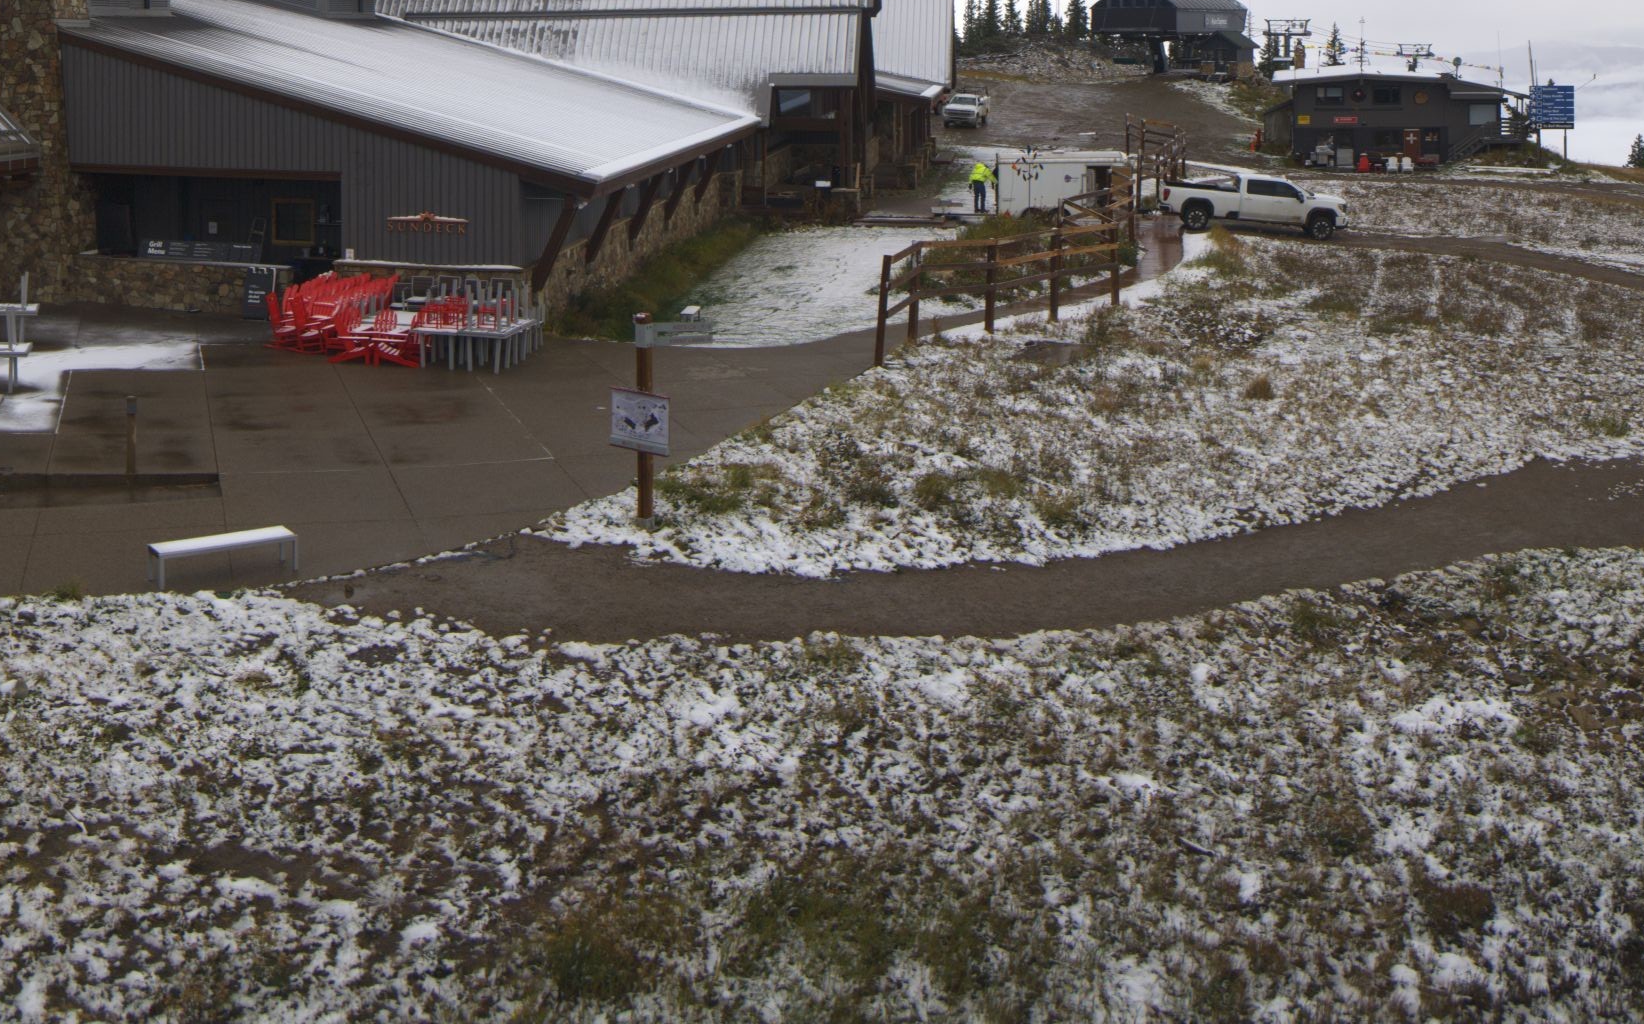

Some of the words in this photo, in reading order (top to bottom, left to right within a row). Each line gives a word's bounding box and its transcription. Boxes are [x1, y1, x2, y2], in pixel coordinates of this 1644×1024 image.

[387, 221, 466, 233] SUNDECK
[149, 240, 163, 248] Grill
[147, 247, 165, 255] Menu
